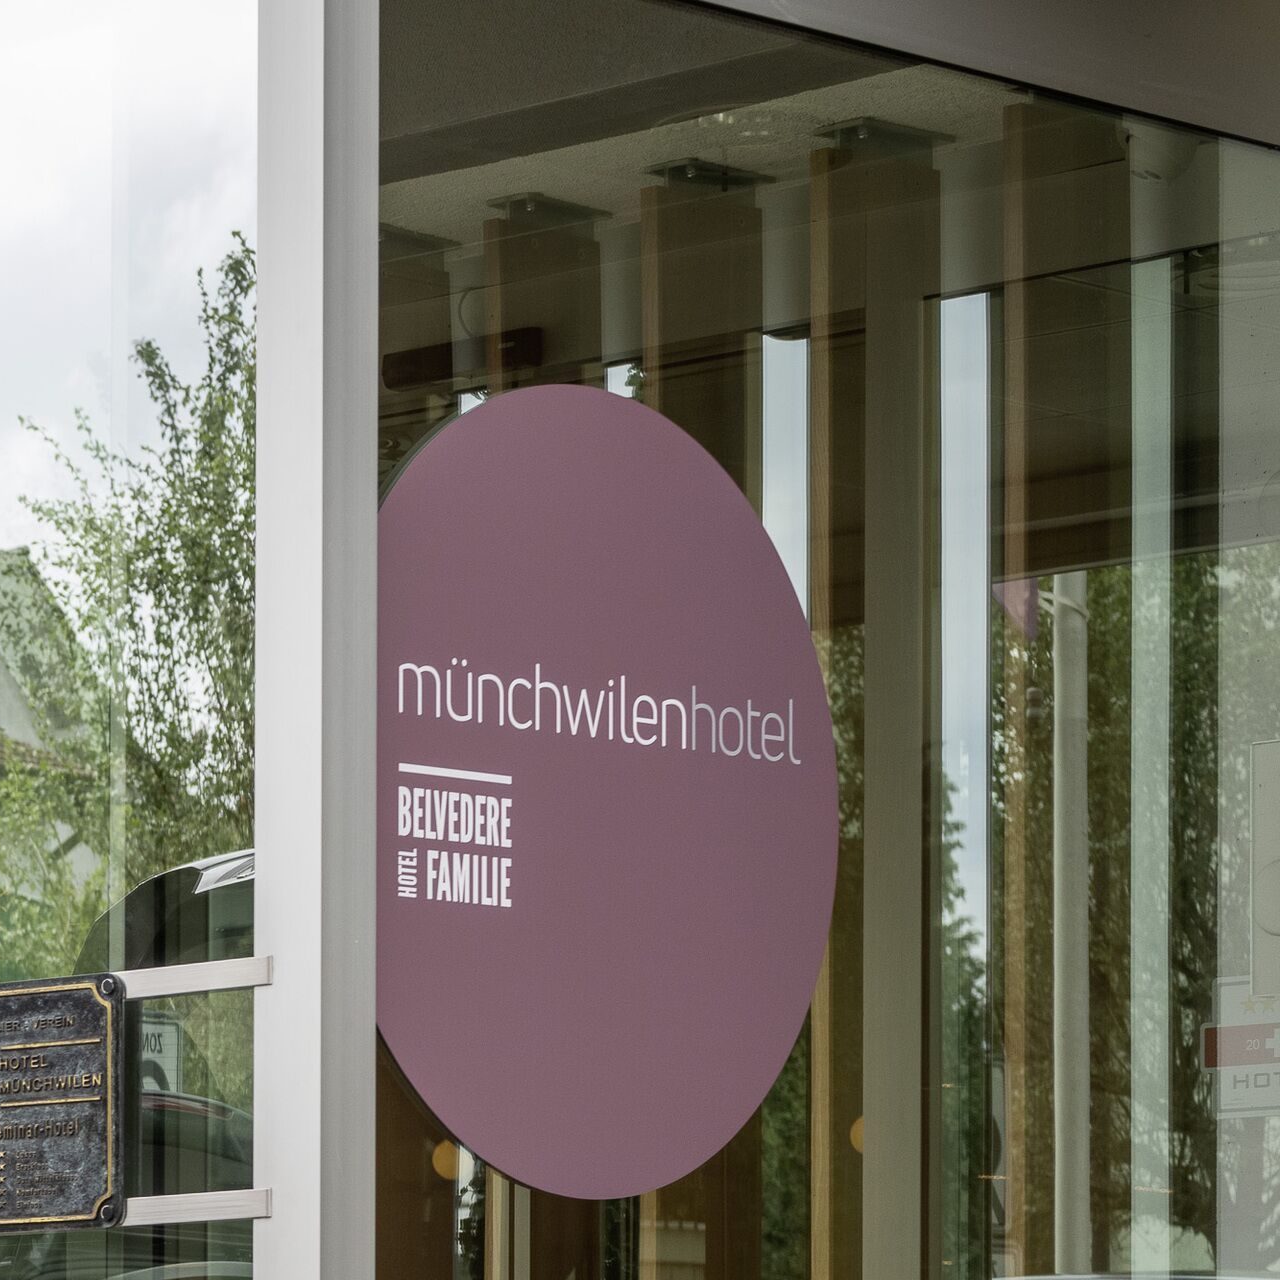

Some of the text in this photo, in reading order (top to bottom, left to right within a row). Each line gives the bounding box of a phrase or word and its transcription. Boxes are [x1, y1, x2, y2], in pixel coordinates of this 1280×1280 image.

[398, 657, 802, 765] münchwilenhotel
[397, 785, 513, 848] BELVEDERE
[397, 848, 418, 898] HOTEL
[426, 849, 513, 908] FAMILIE
[32, 1015, 75, 1029] VEREIN
[0, 1055, 48, 1071] HOTEL
